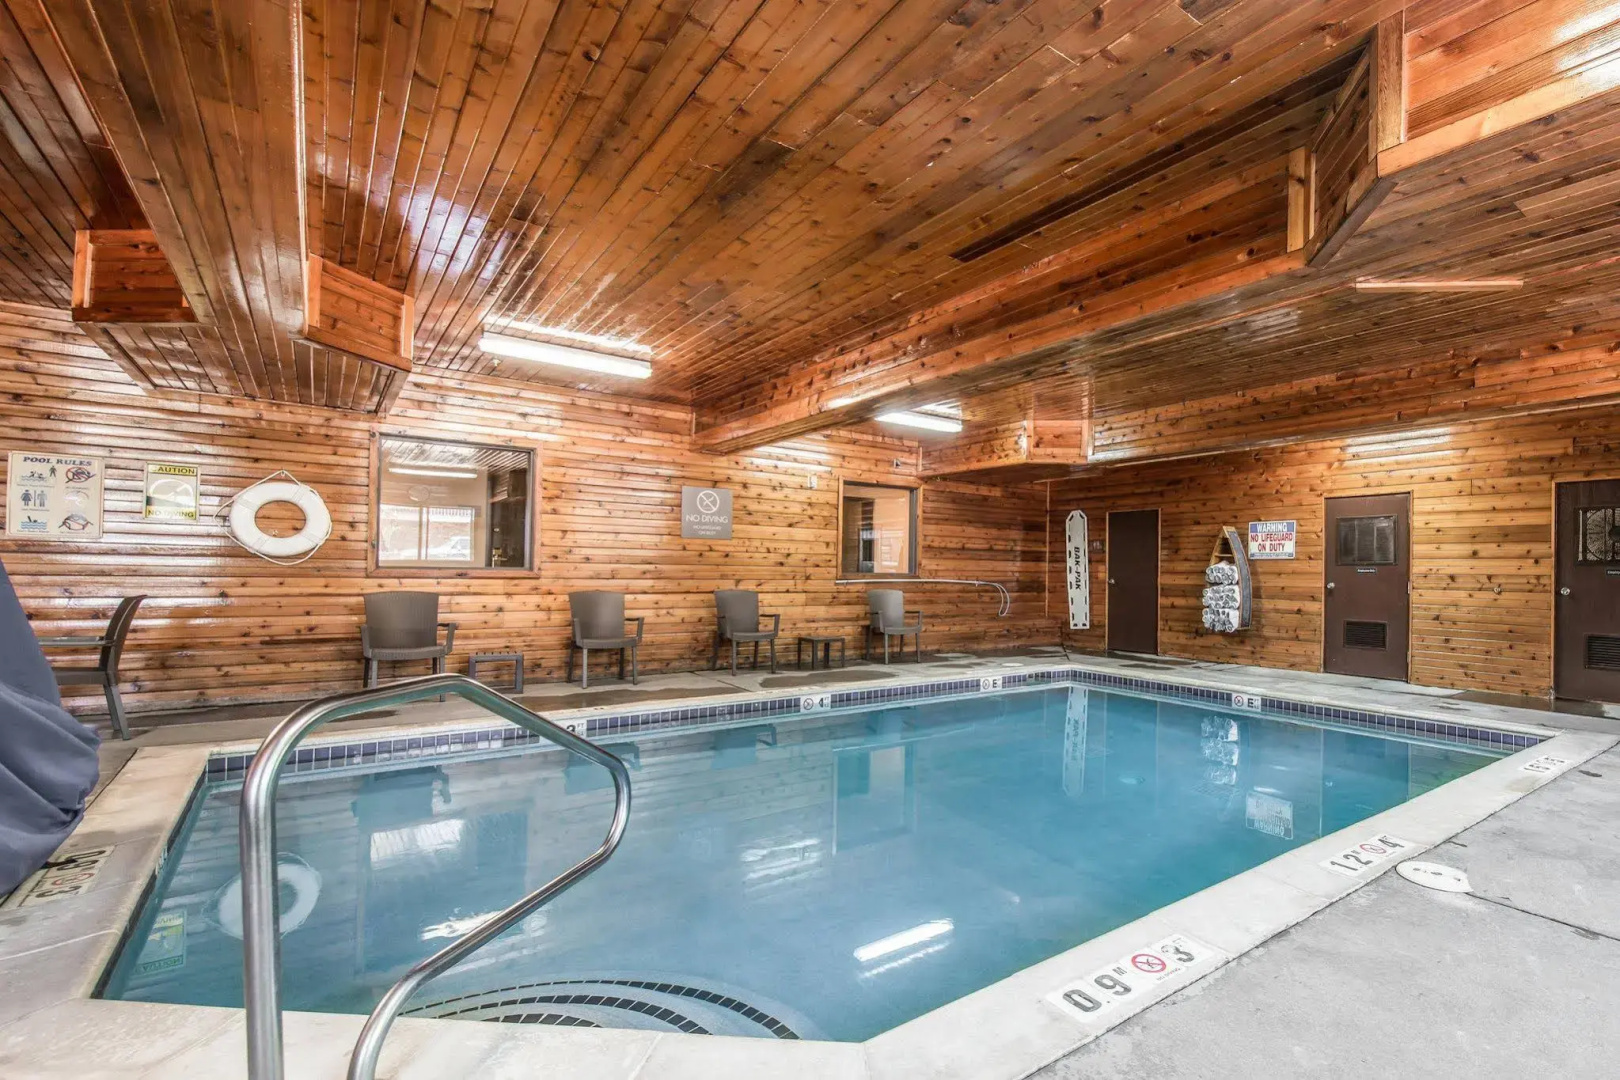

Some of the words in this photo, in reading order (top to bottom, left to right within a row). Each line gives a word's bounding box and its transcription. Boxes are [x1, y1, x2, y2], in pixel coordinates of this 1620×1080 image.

[23, 456, 53, 464] POOL
[151, 466, 195, 474] AUTION
[702, 515, 729, 524] DIVING
[1256, 522, 1288, 533] WARNING
[1251, 534, 1259, 542] NO
[1261, 533, 1293, 542] LIFEGUARD
[1258, 543, 1266, 552] ON
[1270, 542, 1286, 552] DUTY
